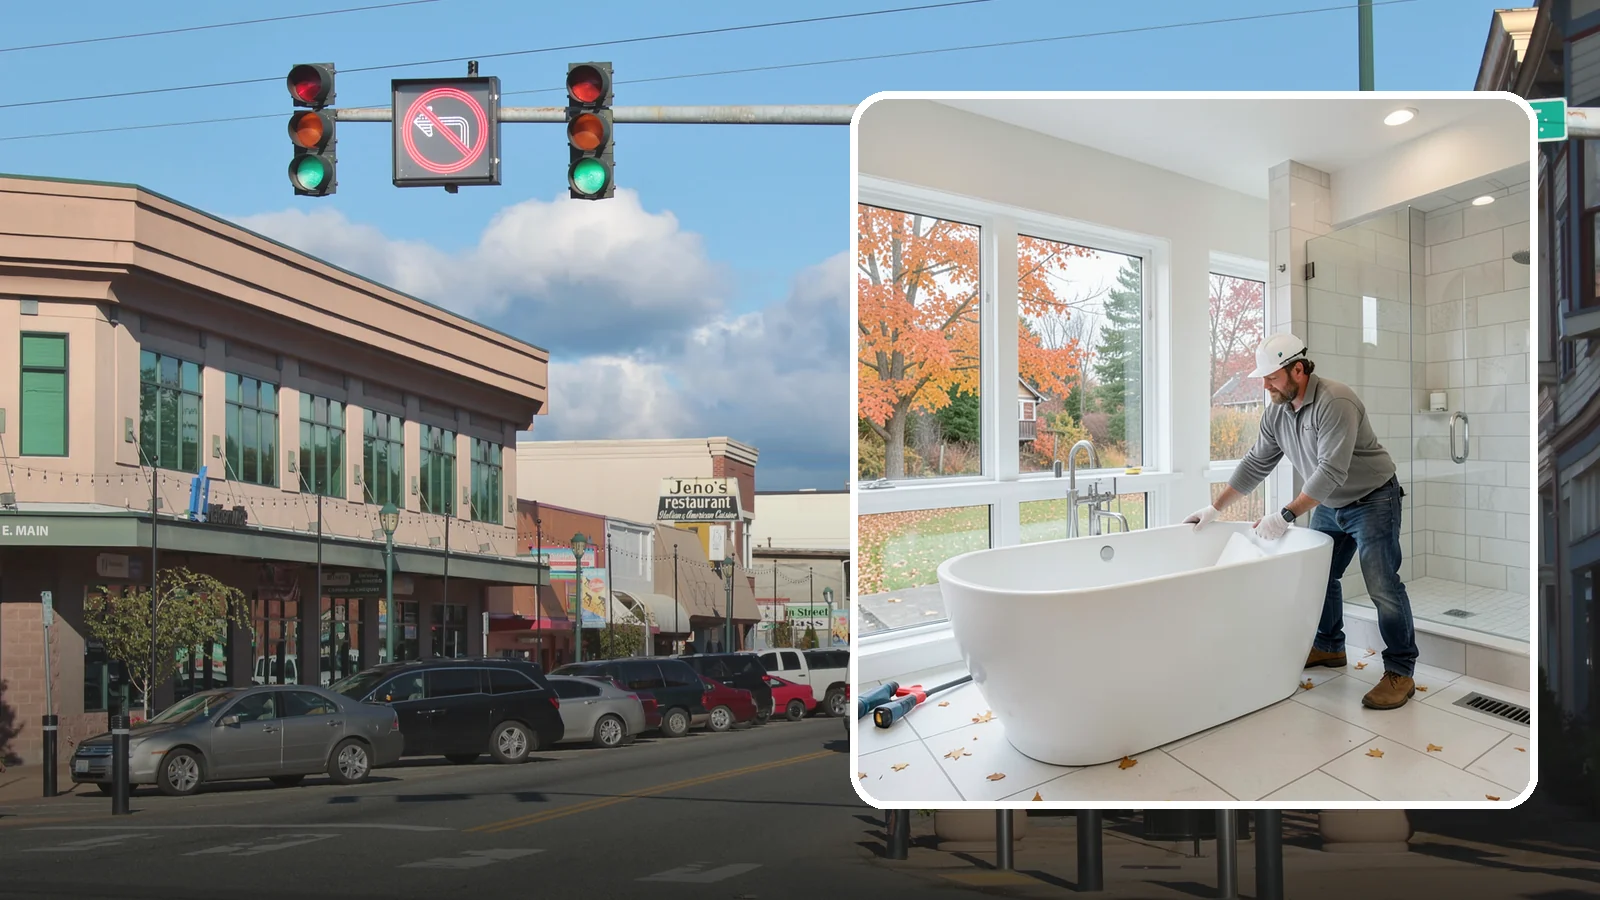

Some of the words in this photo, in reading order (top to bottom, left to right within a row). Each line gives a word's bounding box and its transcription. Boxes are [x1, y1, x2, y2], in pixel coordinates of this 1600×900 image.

[669, 479, 728, 494] Jeno's
[665, 496, 731, 509] restaurant
[658, 509, 682, 520] Italian
[686, 509, 715, 519] American
[714, 509, 738, 520] Cuisine
[2, 525, 13, 536] E.
[15, 525, 49, 536] MAIN
[797, 608, 828, 616] Street
